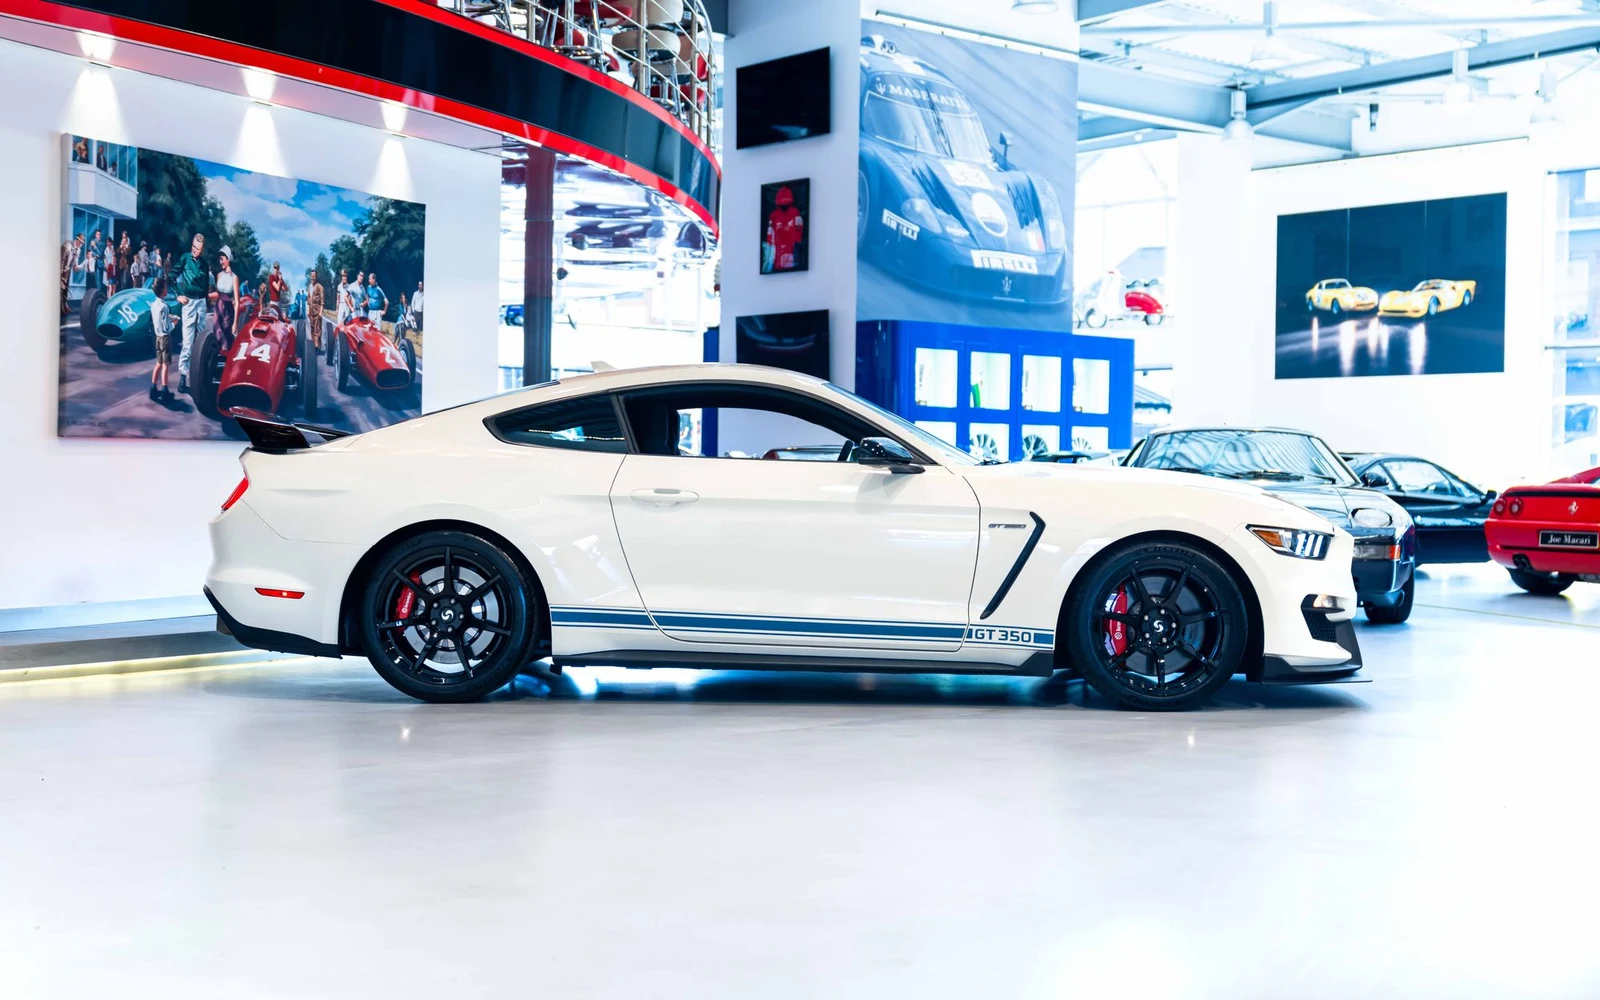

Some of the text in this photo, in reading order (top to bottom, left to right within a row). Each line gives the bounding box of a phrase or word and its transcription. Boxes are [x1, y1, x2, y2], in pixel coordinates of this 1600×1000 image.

[889, 83, 970, 111] MASERATI
[970, 249, 1038, 275] PIRELLI
[117, 304, 138, 324] 18
[232, 342, 271, 364] 14
[379, 346, 396, 364] 2
[1547, 534, 1591, 545] Joe Macari
[975, 628, 1032, 643] GT 350
